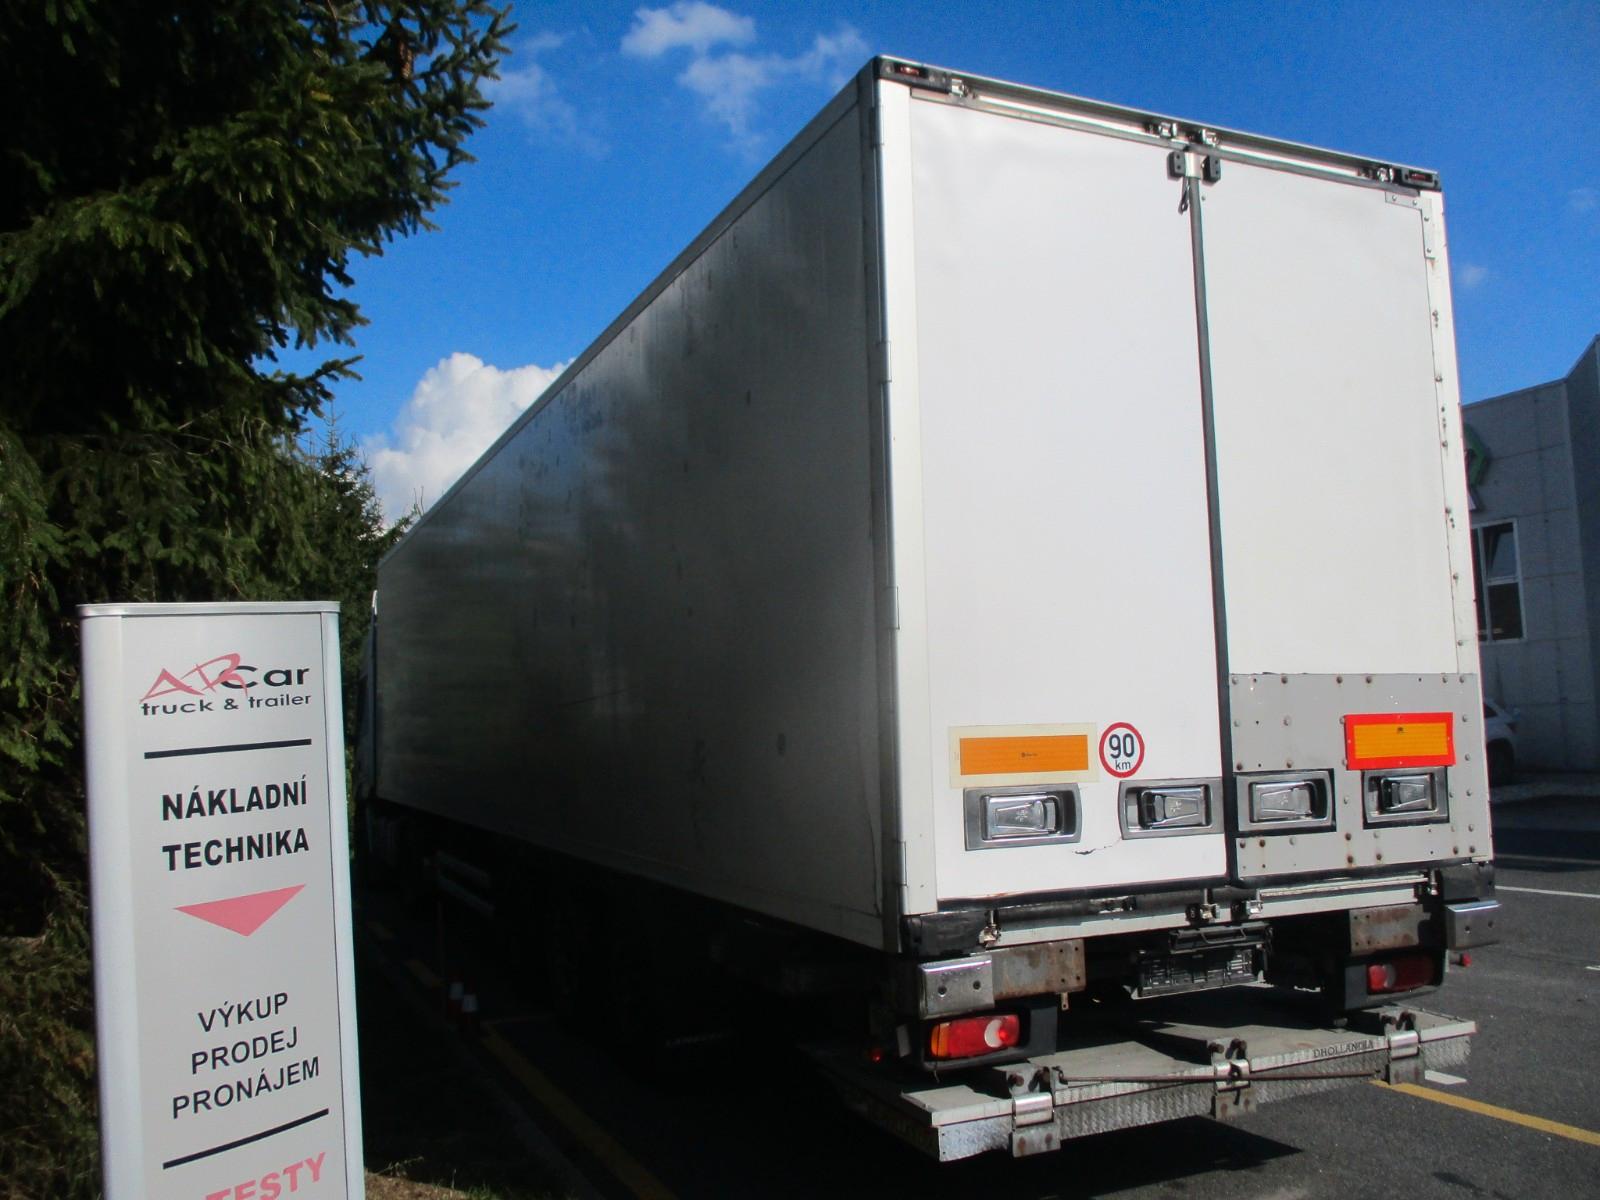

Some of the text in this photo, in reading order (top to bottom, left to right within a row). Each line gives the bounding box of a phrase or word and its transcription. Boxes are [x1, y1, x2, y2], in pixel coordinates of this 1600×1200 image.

[141, 693, 312, 716] truck & trailer
[1109, 733, 1135, 759] 90
[1115, 760, 1131, 770] km
[162, 774, 308, 821] NÁKLADNÍ
[162, 827, 310, 871] TECHNIKA
[198, 992, 288, 1033] VÝKUP
[191, 1026, 298, 1075] PRODEJ
[172, 1056, 320, 1120] PRONÁJEM
